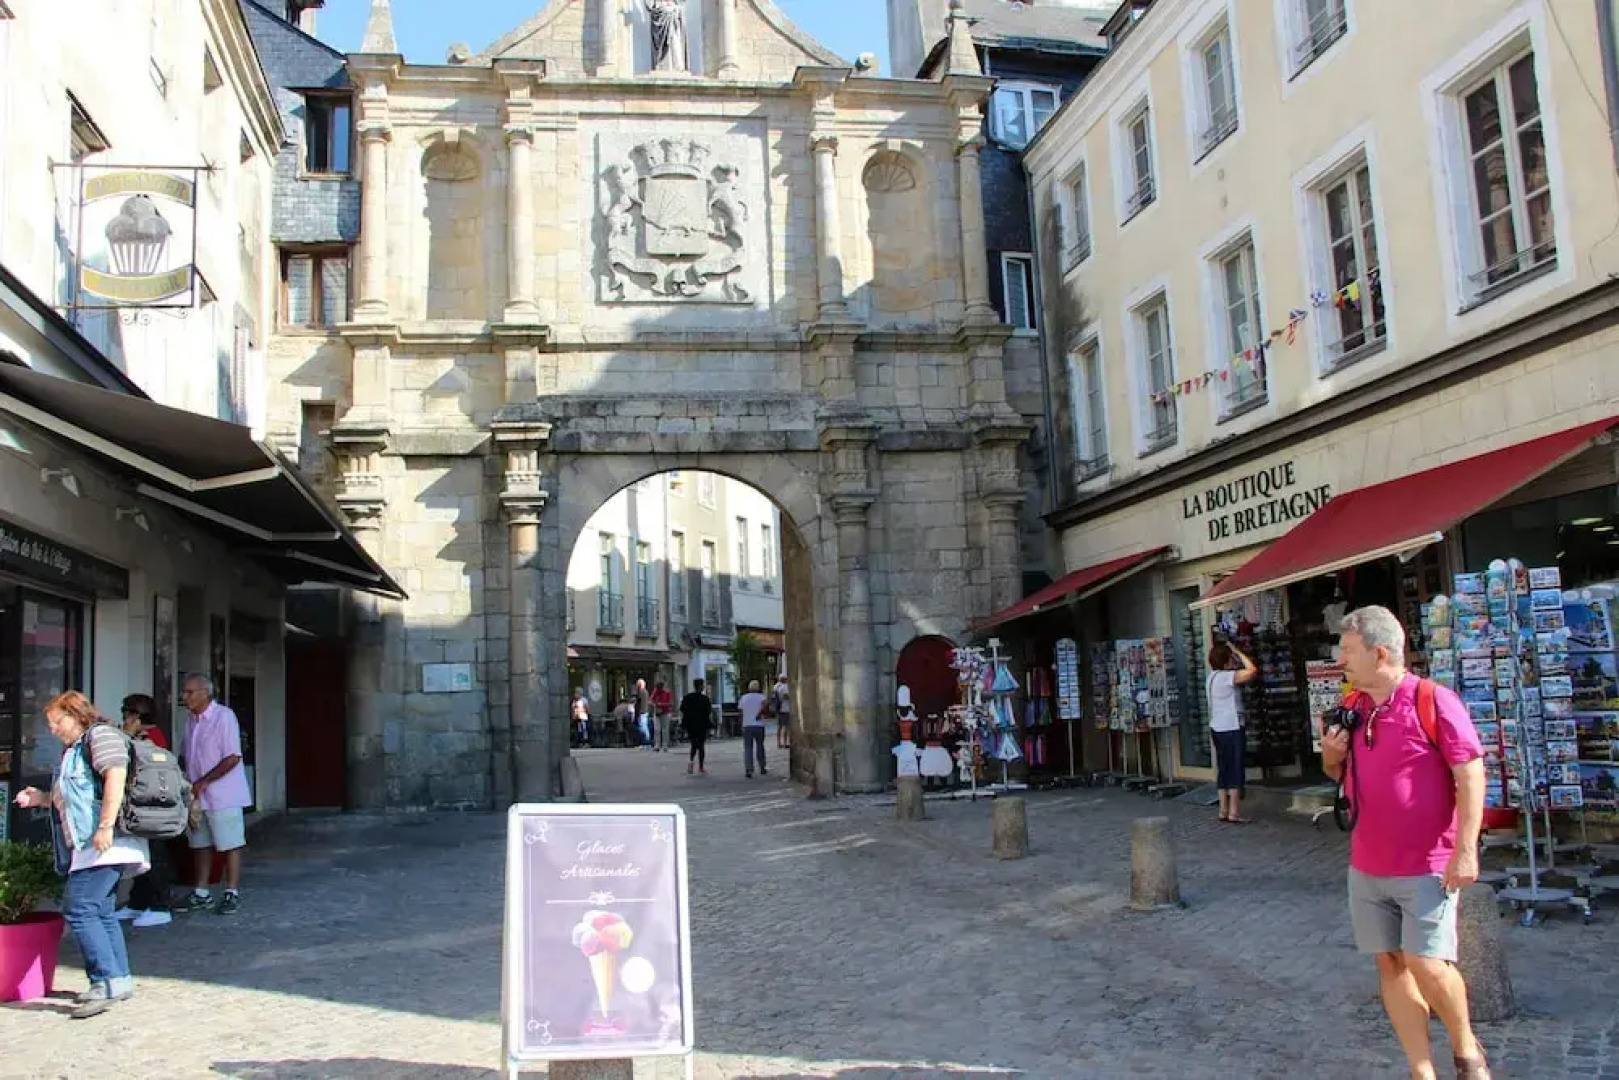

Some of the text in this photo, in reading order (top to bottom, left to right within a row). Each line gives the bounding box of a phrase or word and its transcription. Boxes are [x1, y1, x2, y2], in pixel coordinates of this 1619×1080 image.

[1183, 461, 1296, 518] LA BOUTIQUE
[1208, 483, 1331, 541] DE BRETAGNE
[577, 839, 626, 861] Glaces
